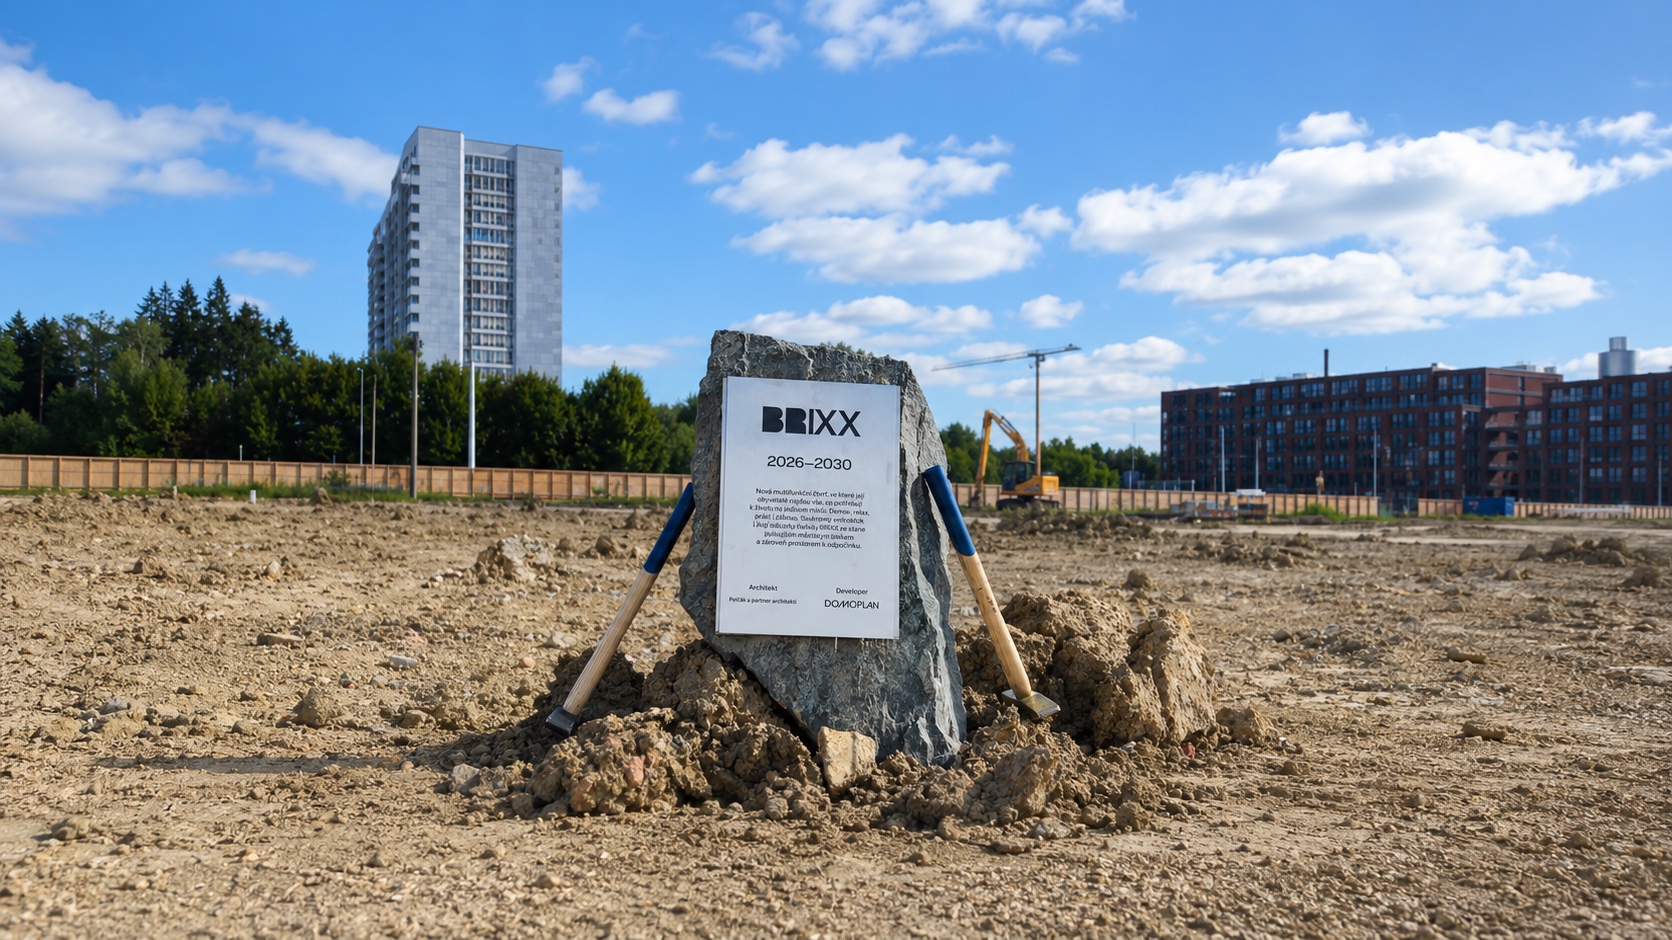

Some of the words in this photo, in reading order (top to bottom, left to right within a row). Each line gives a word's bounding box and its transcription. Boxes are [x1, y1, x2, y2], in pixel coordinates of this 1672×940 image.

[762, 406, 861, 437] BRIXX
[836, 587, 868, 596] Developer
[824, 599, 880, 610] DOMOPLAN
